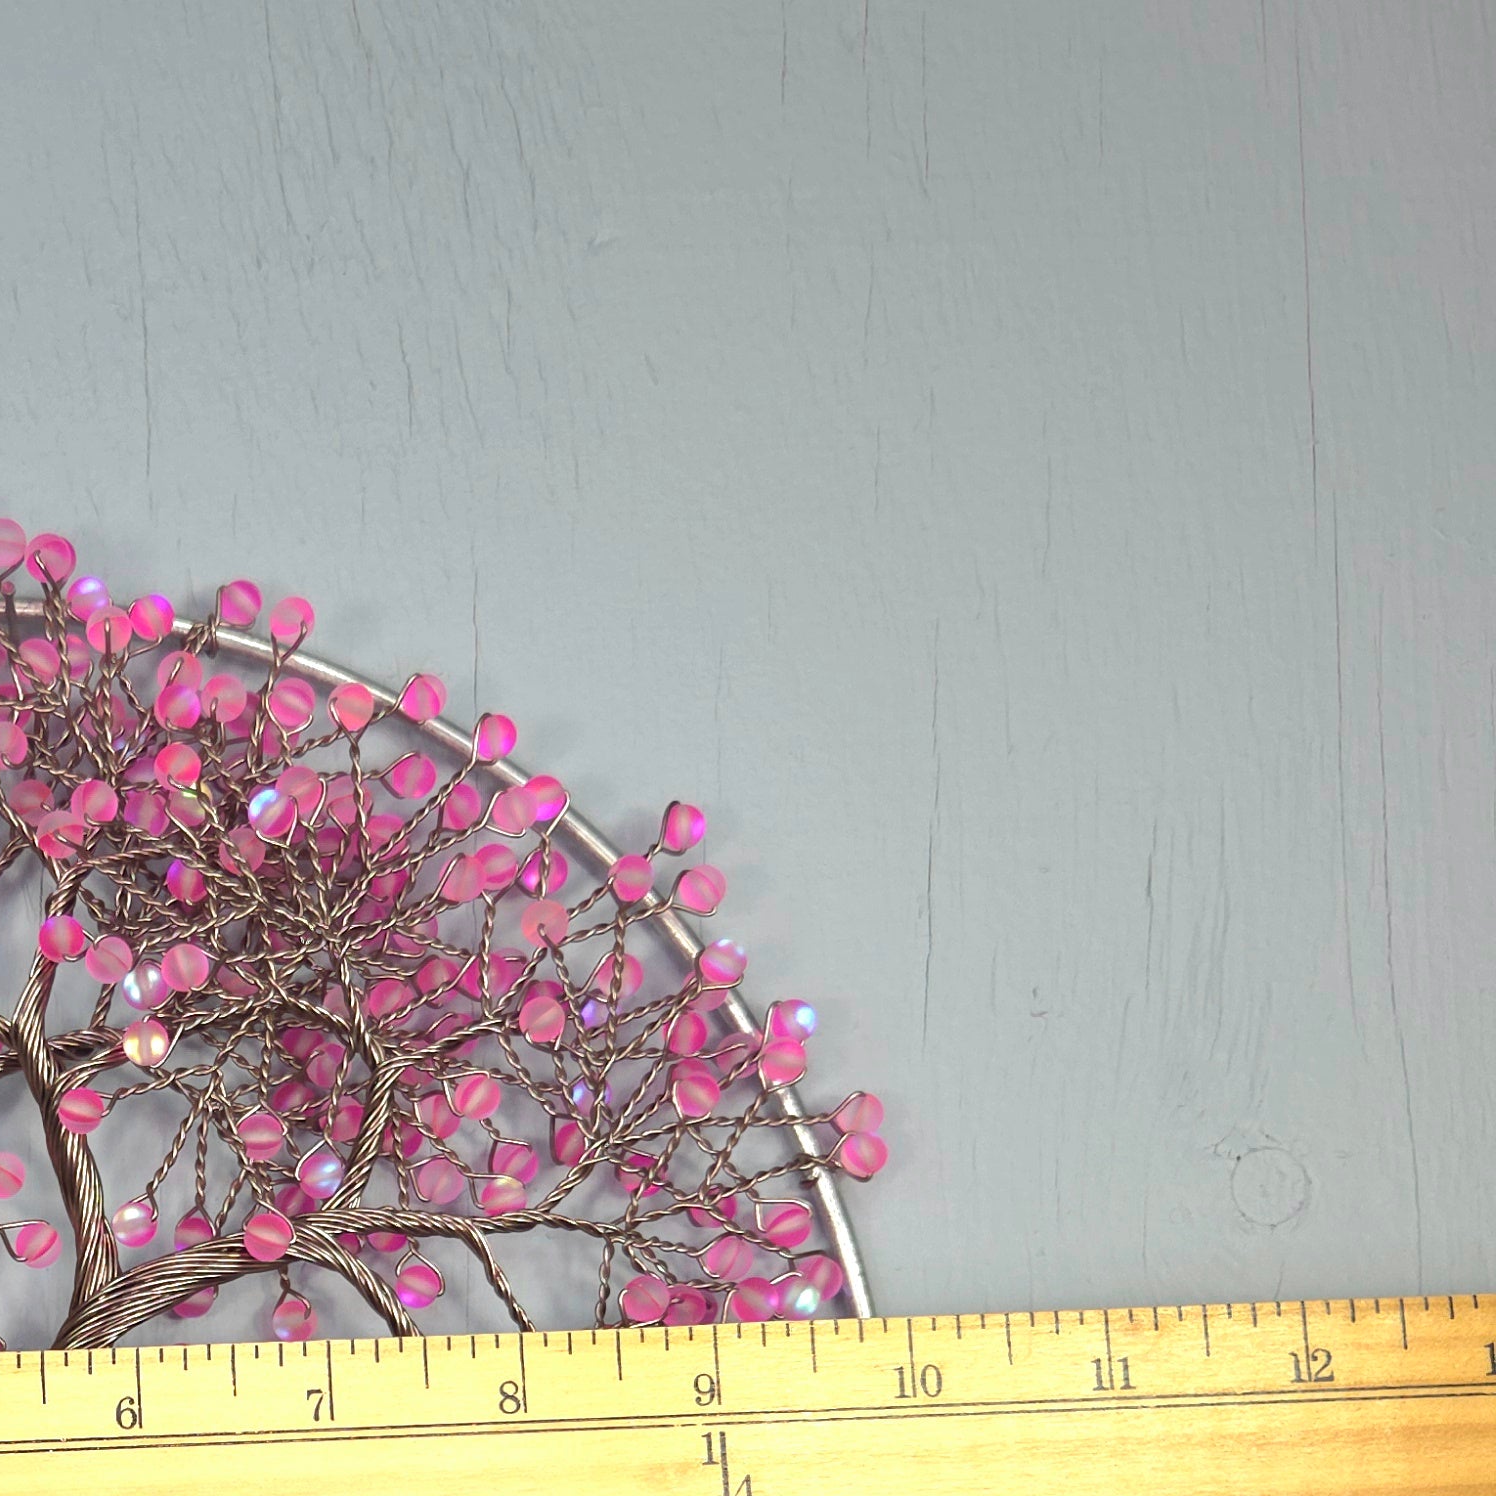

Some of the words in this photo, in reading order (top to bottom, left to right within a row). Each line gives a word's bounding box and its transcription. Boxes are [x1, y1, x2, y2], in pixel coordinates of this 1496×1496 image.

[115, 1396, 137, 1429] 6
[306, 1389, 326, 1421] 7
[498, 1380, 522, 1414] 8
[694, 1373, 715, 1406] 9
[894, 1364, 943, 1399] 10
[1090, 1356, 1137, 1391] 11
[1288, 1348, 1335, 1384] 12
